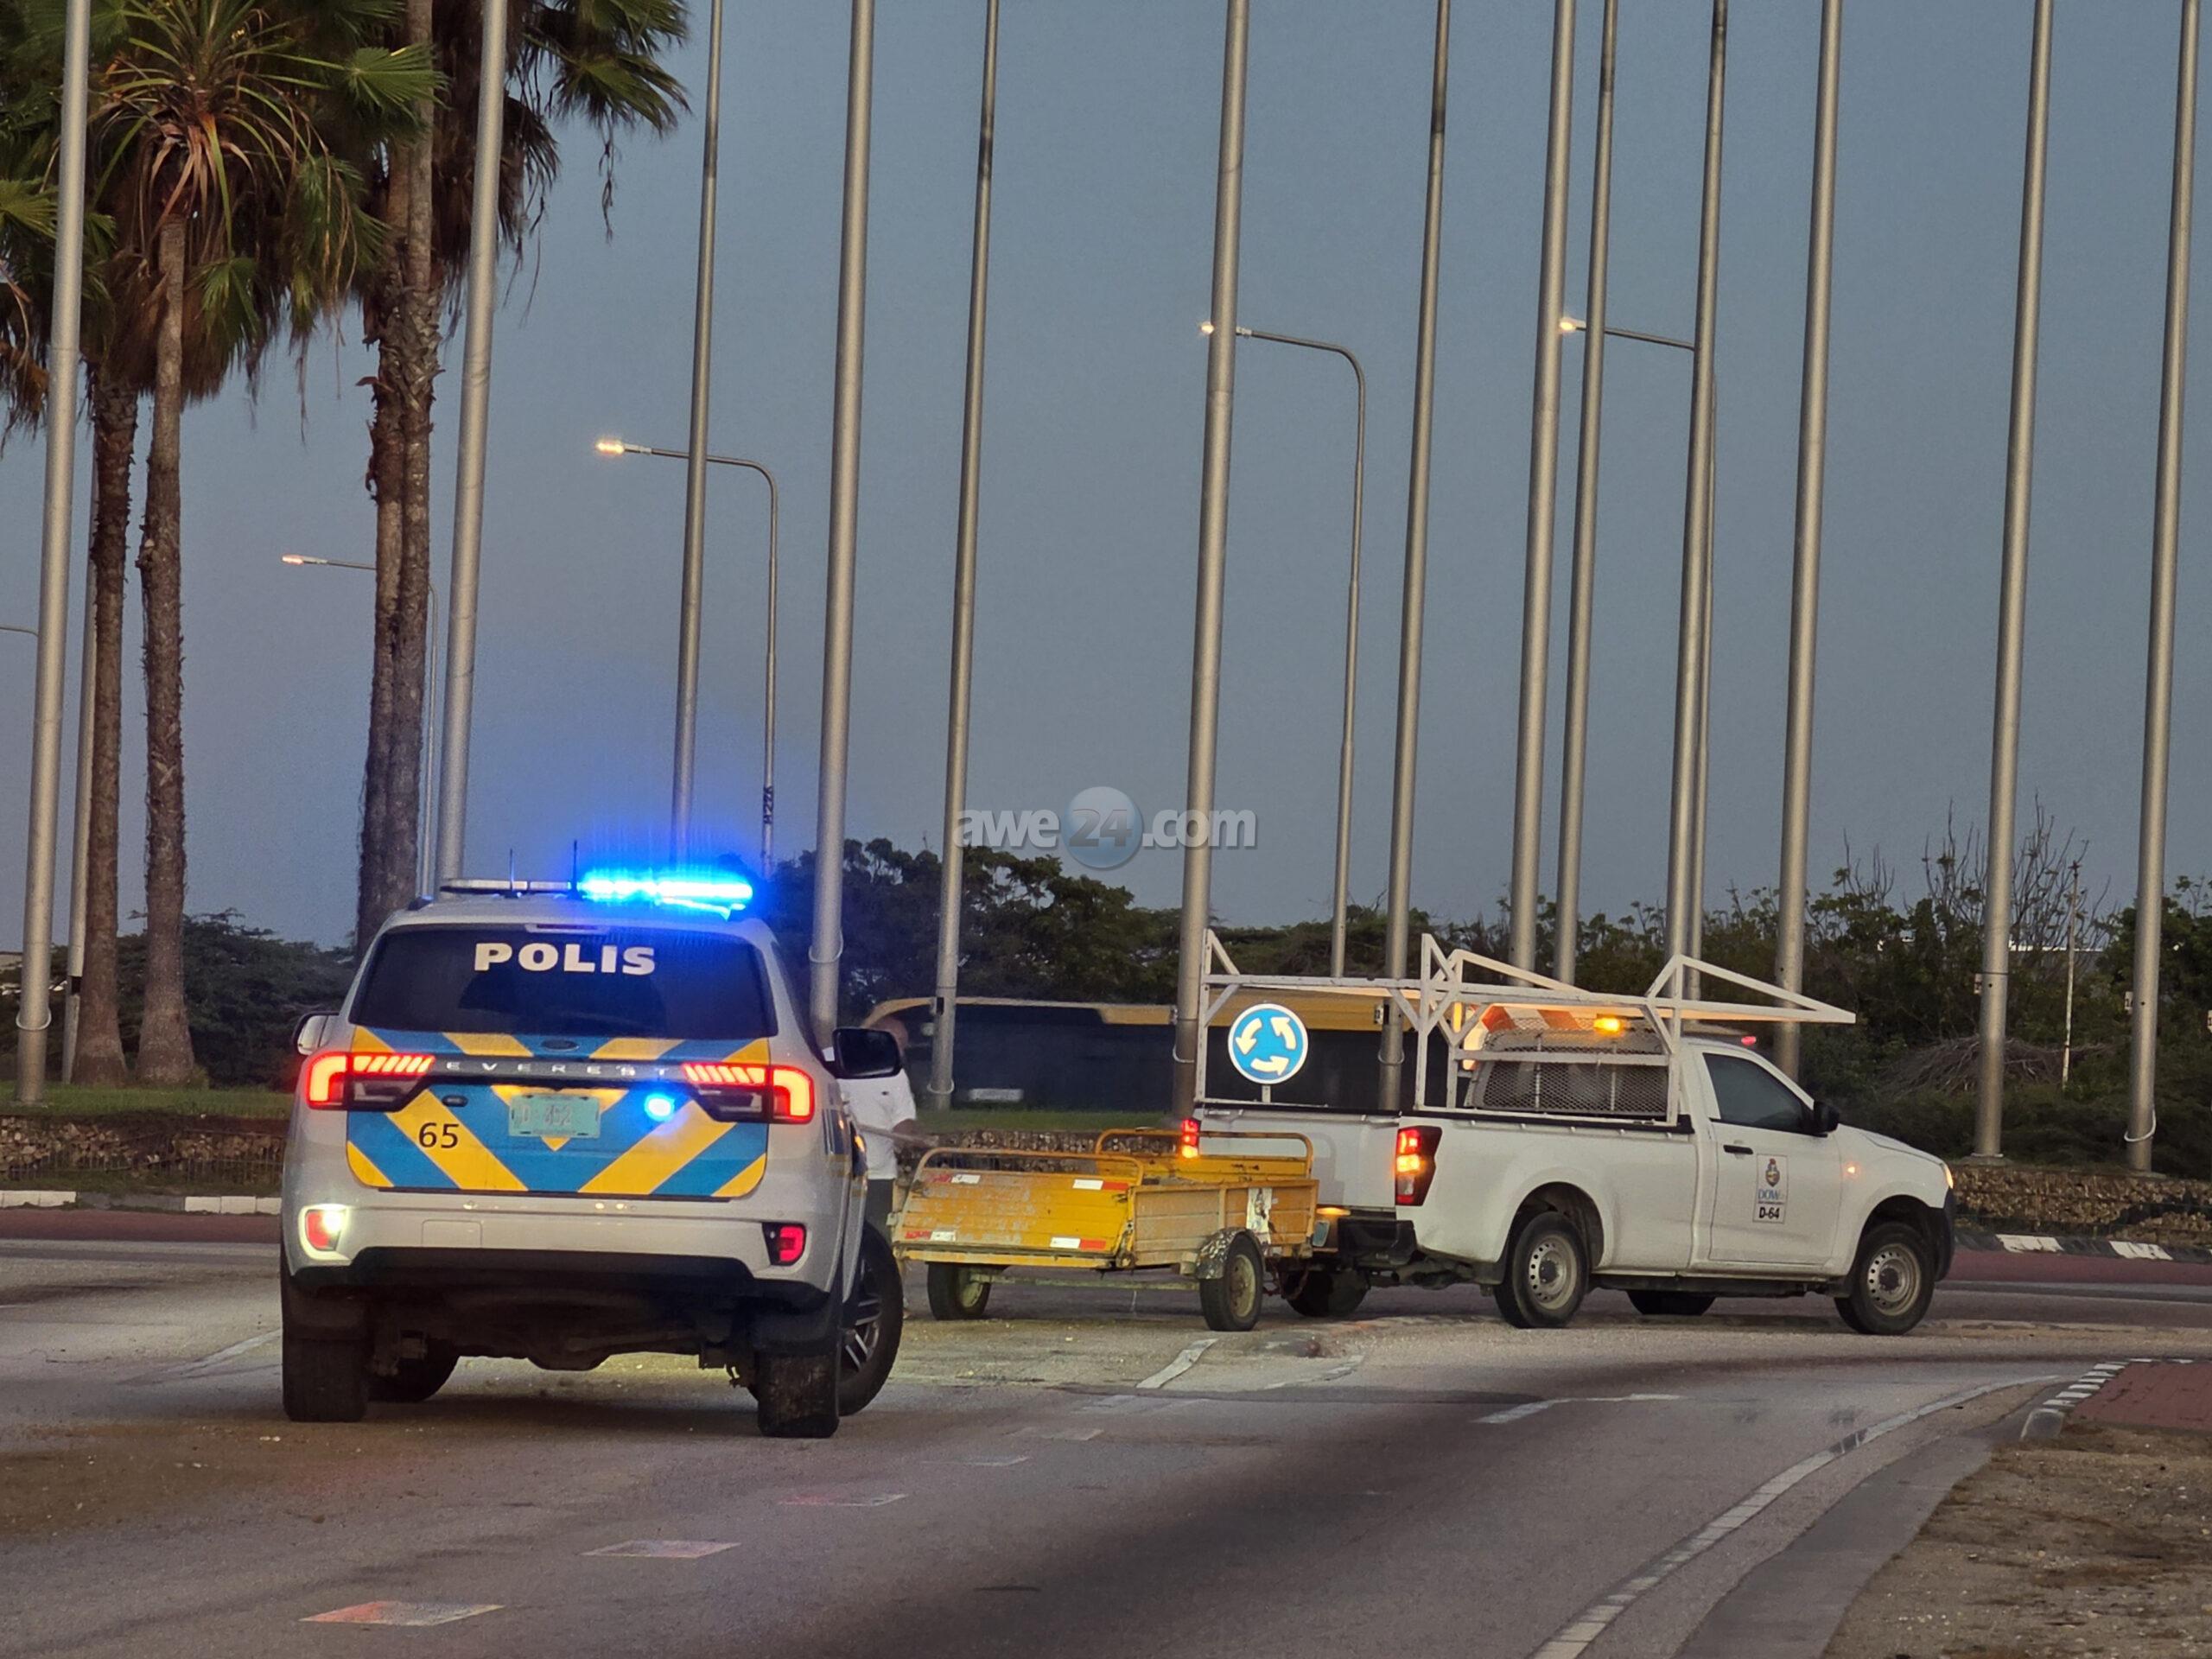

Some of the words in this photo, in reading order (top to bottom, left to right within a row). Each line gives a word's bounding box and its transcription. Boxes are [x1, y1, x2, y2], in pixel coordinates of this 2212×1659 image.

[474, 943, 655, 976] POLIS
[447, 1062, 670, 1077] EVEREST
[419, 1122, 459, 1148] 65
[1759, 1206, 1780, 1219] D-64
